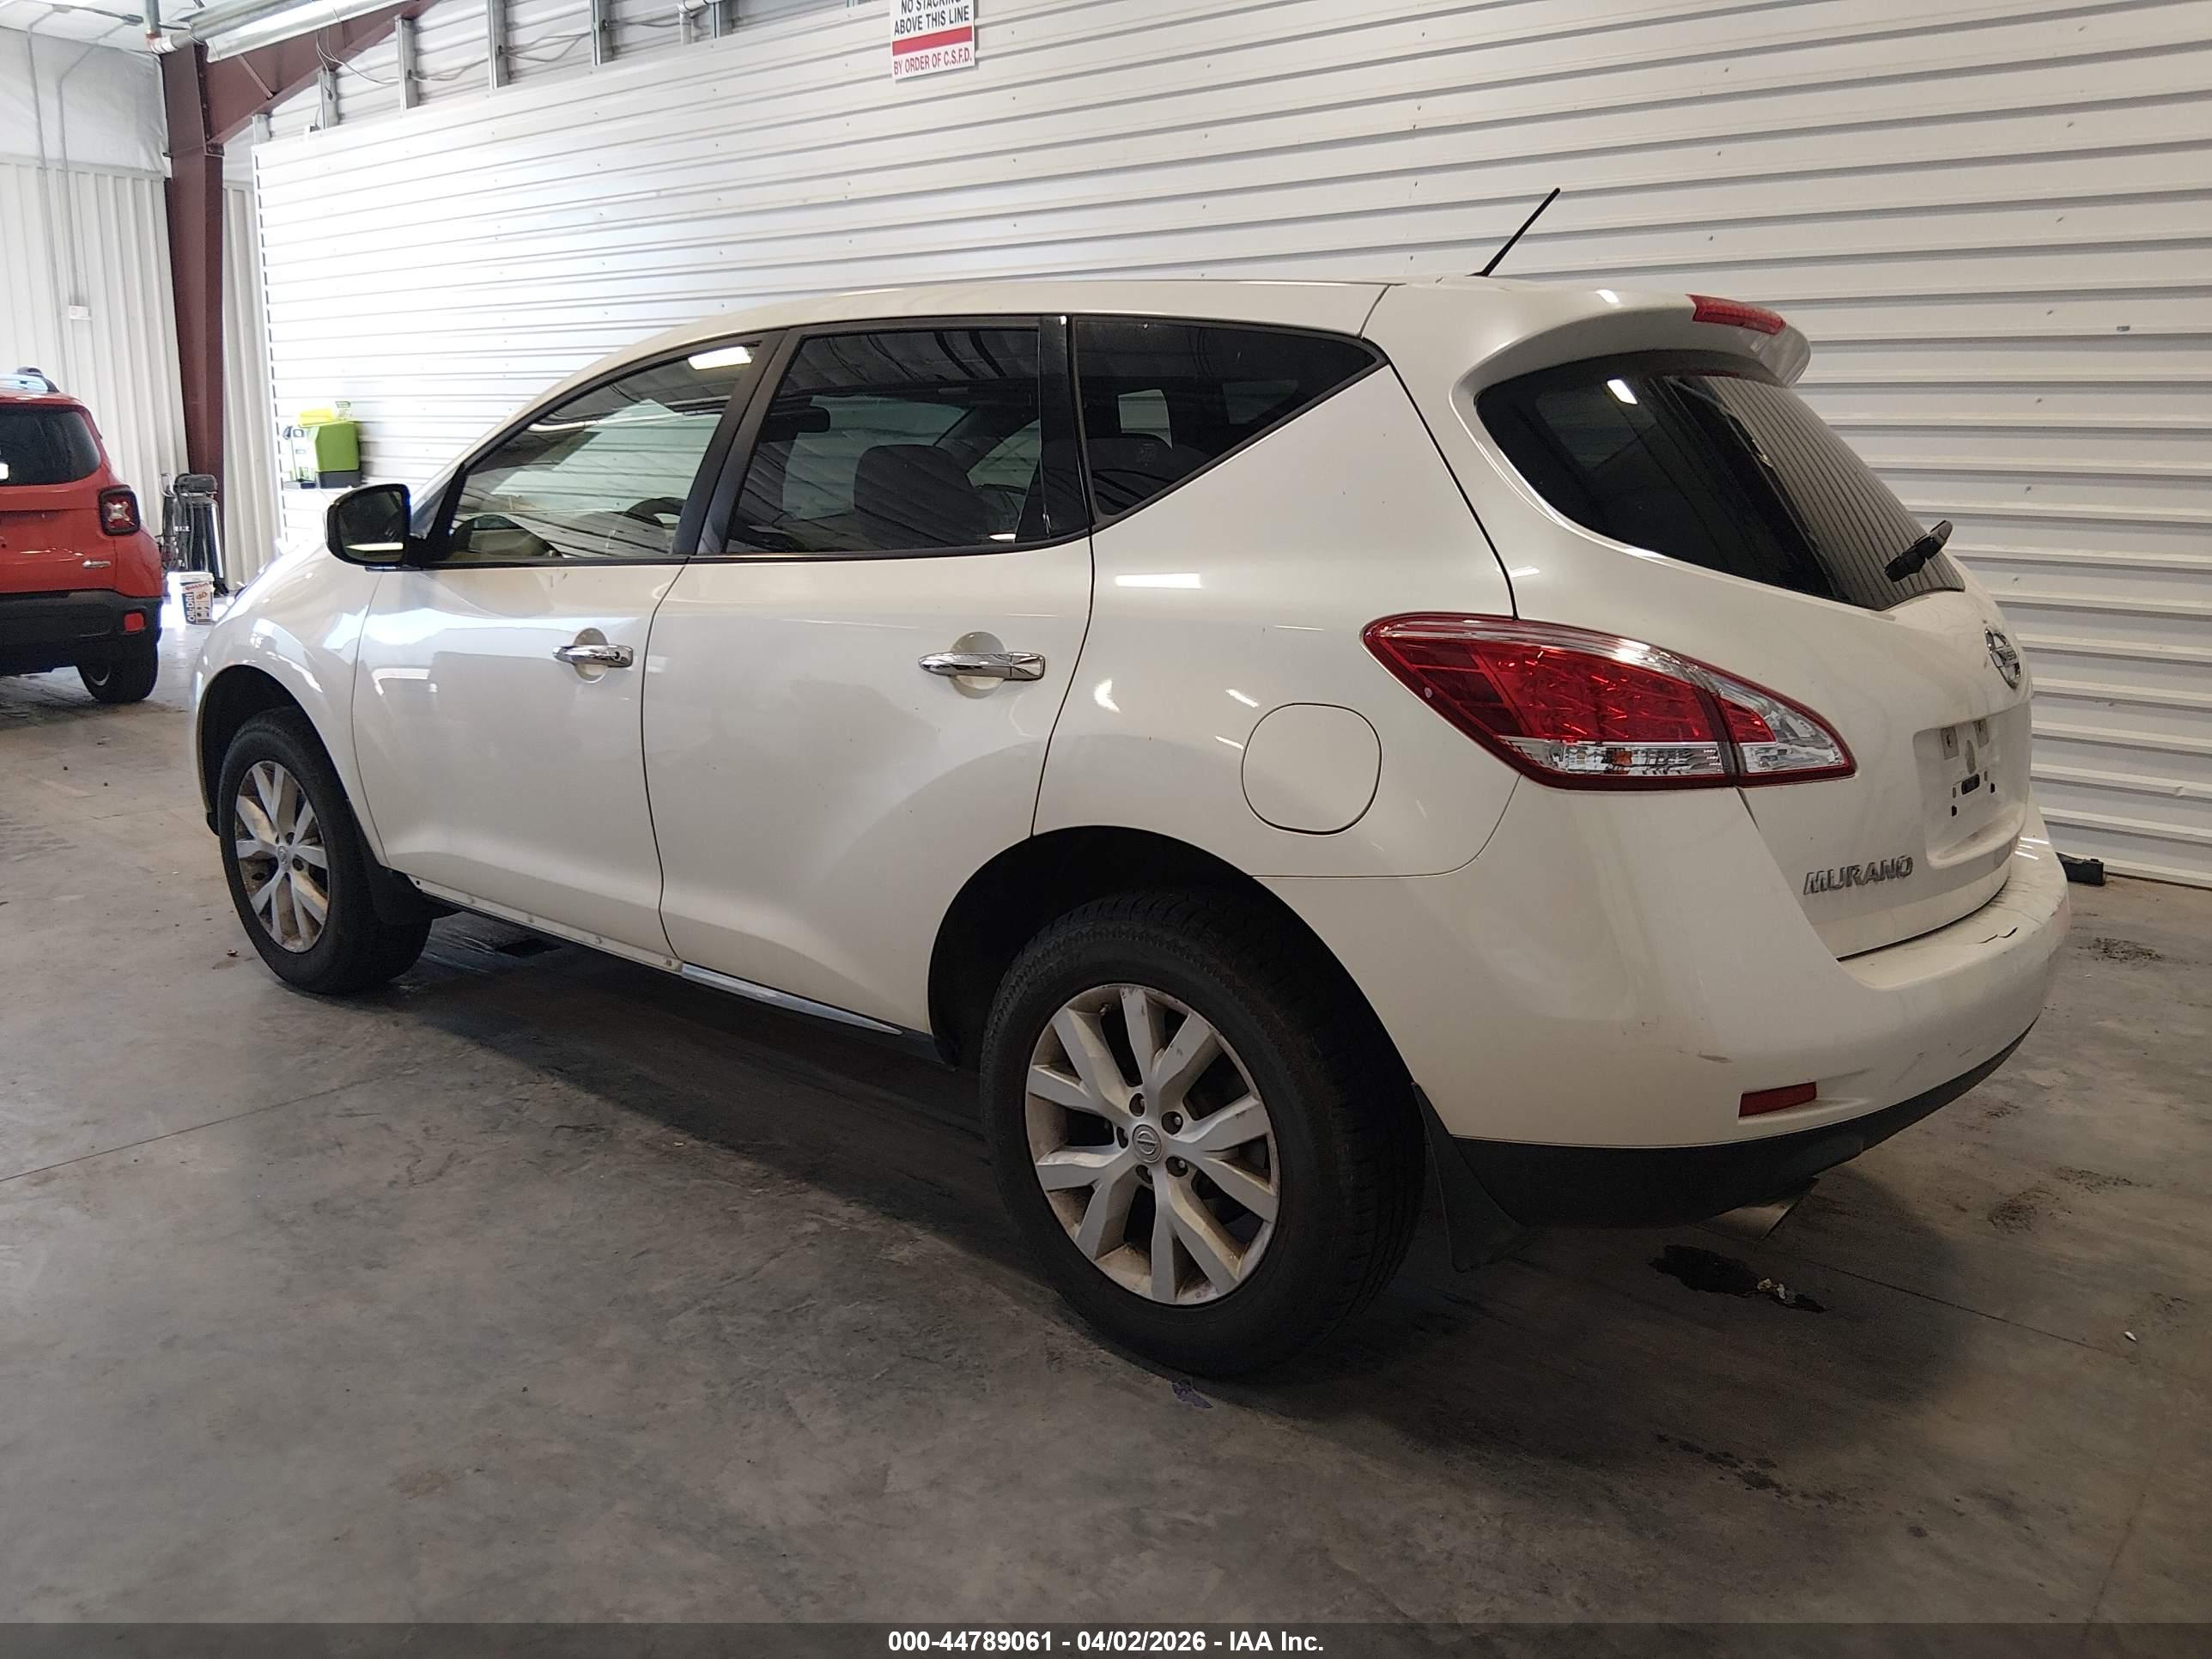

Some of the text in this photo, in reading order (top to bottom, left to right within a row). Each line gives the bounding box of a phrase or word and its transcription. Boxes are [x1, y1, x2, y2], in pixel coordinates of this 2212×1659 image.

[894, 5, 969, 36] ABOVE THIS LINE
[901, 0, 961, 15] NO STAC
[893, 47, 972, 76] BY ORDER OF C.S.F.D.
[1803, 854, 1914, 896] MURANO
